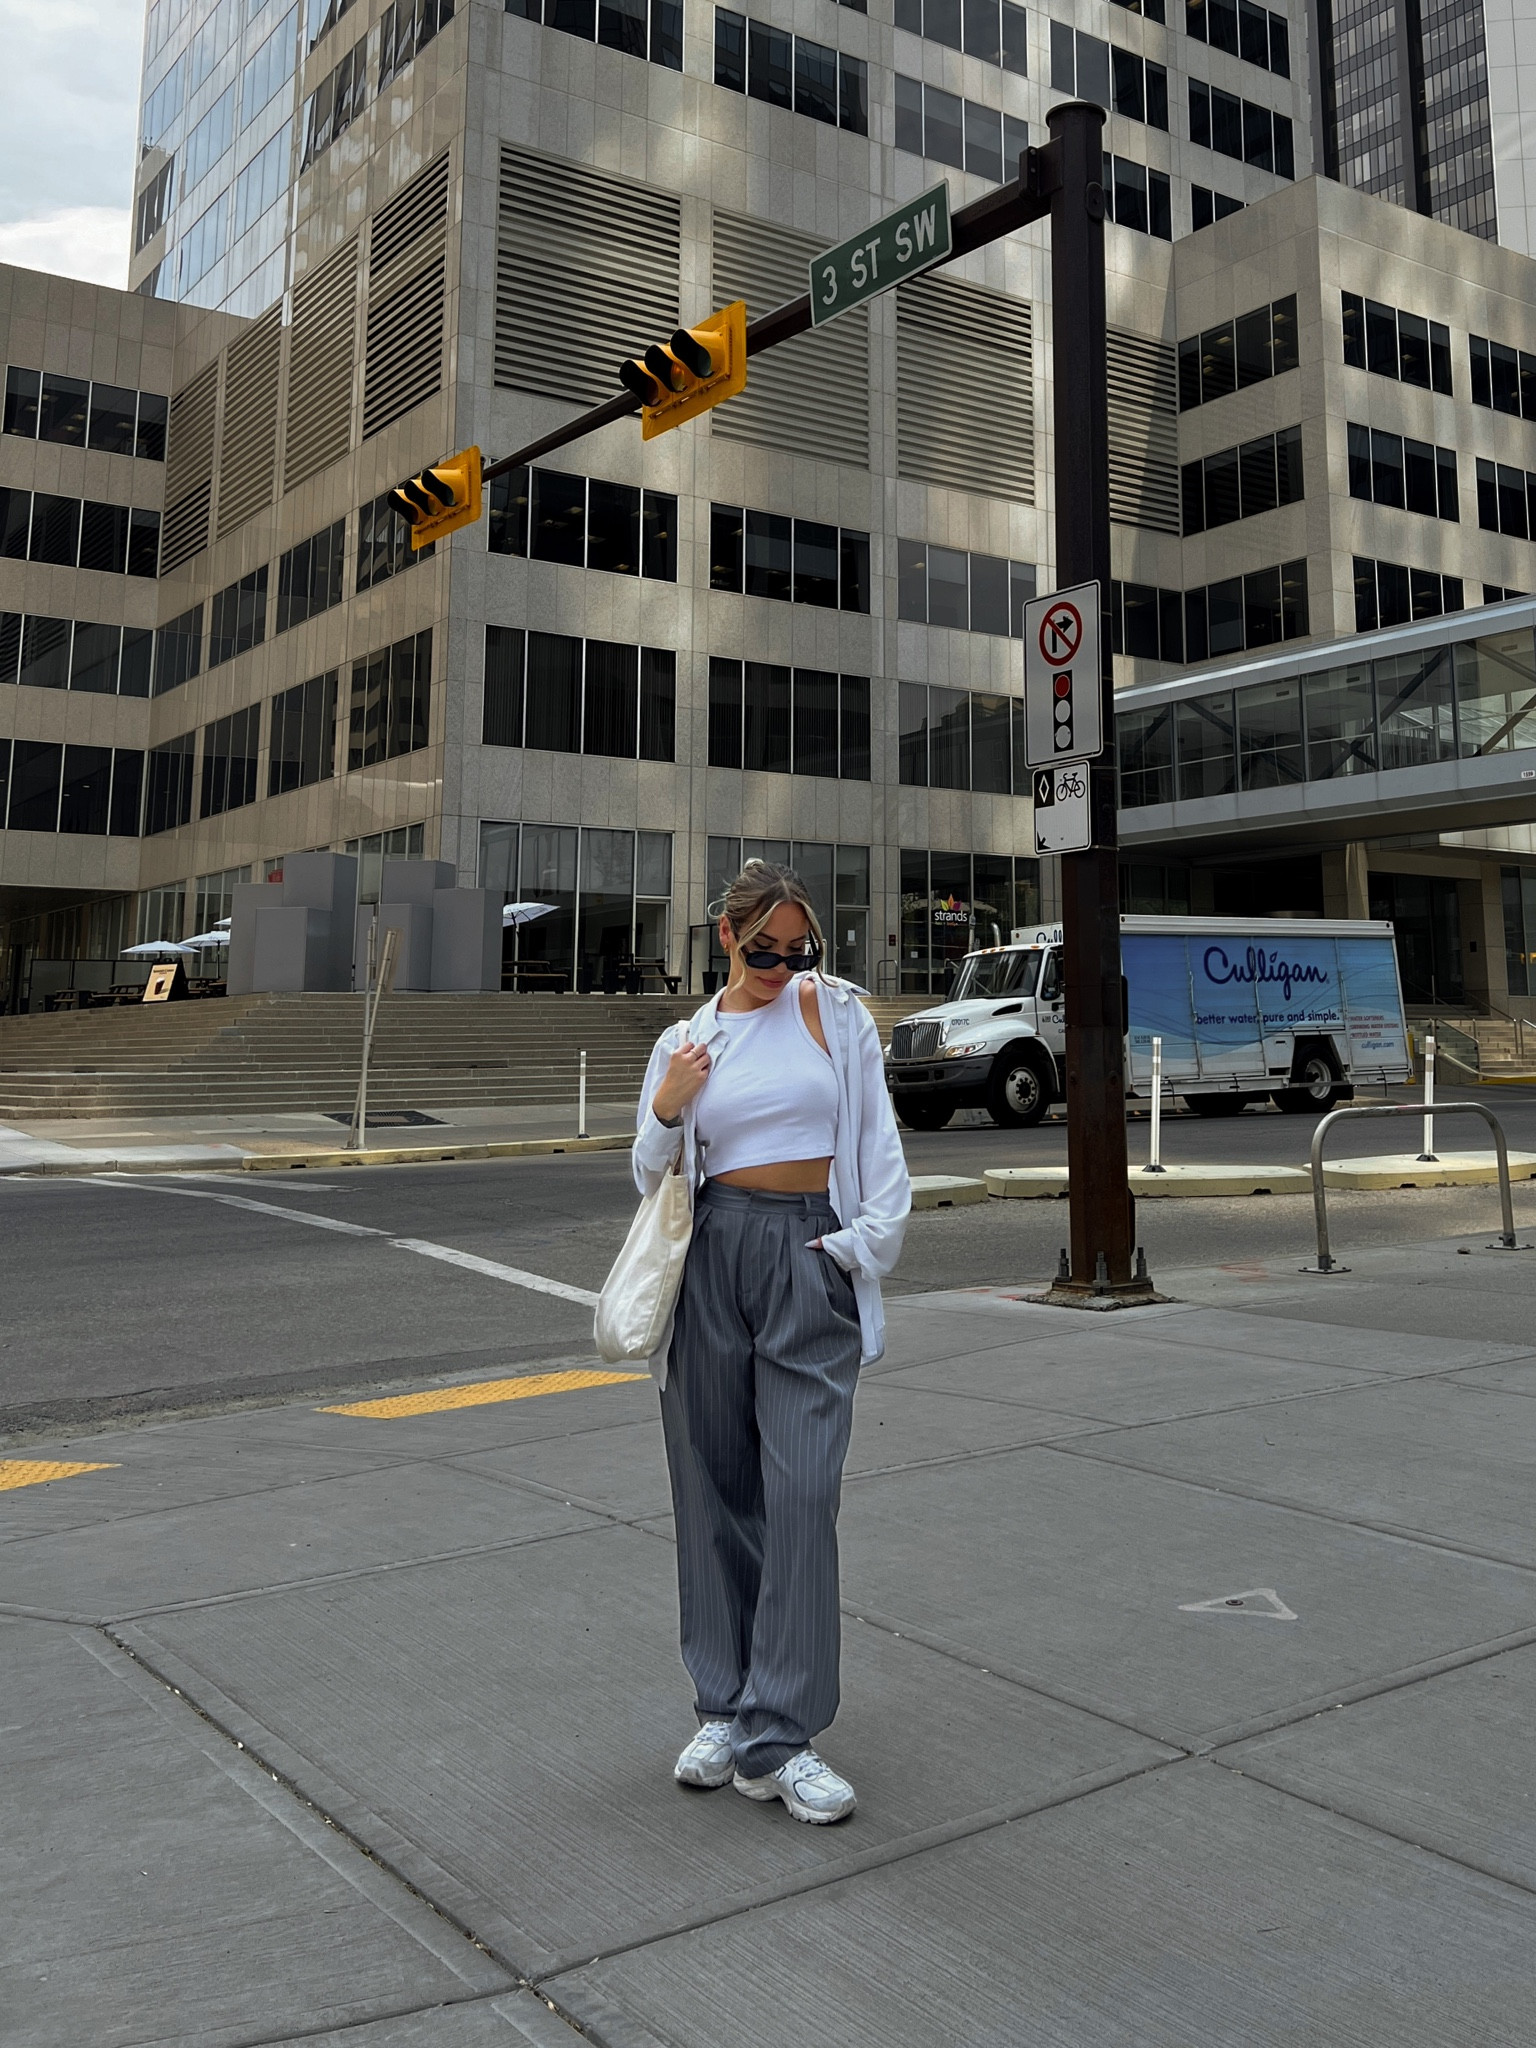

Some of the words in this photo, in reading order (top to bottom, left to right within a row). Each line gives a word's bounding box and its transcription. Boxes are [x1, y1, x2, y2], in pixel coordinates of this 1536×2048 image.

[822, 265, 838, 305] 3
[851, 237, 880, 288] ST
[895, 203, 936, 262] SW
[934, 910, 968, 922] strands
[1203, 946, 1328, 1001] Culligan
[1197, 1013, 1226, 1025] better
[1263, 1013, 1285, 1026] pure
[1287, 1010, 1305, 1022] and
[1307, 1009, 1340, 1025] simple.
